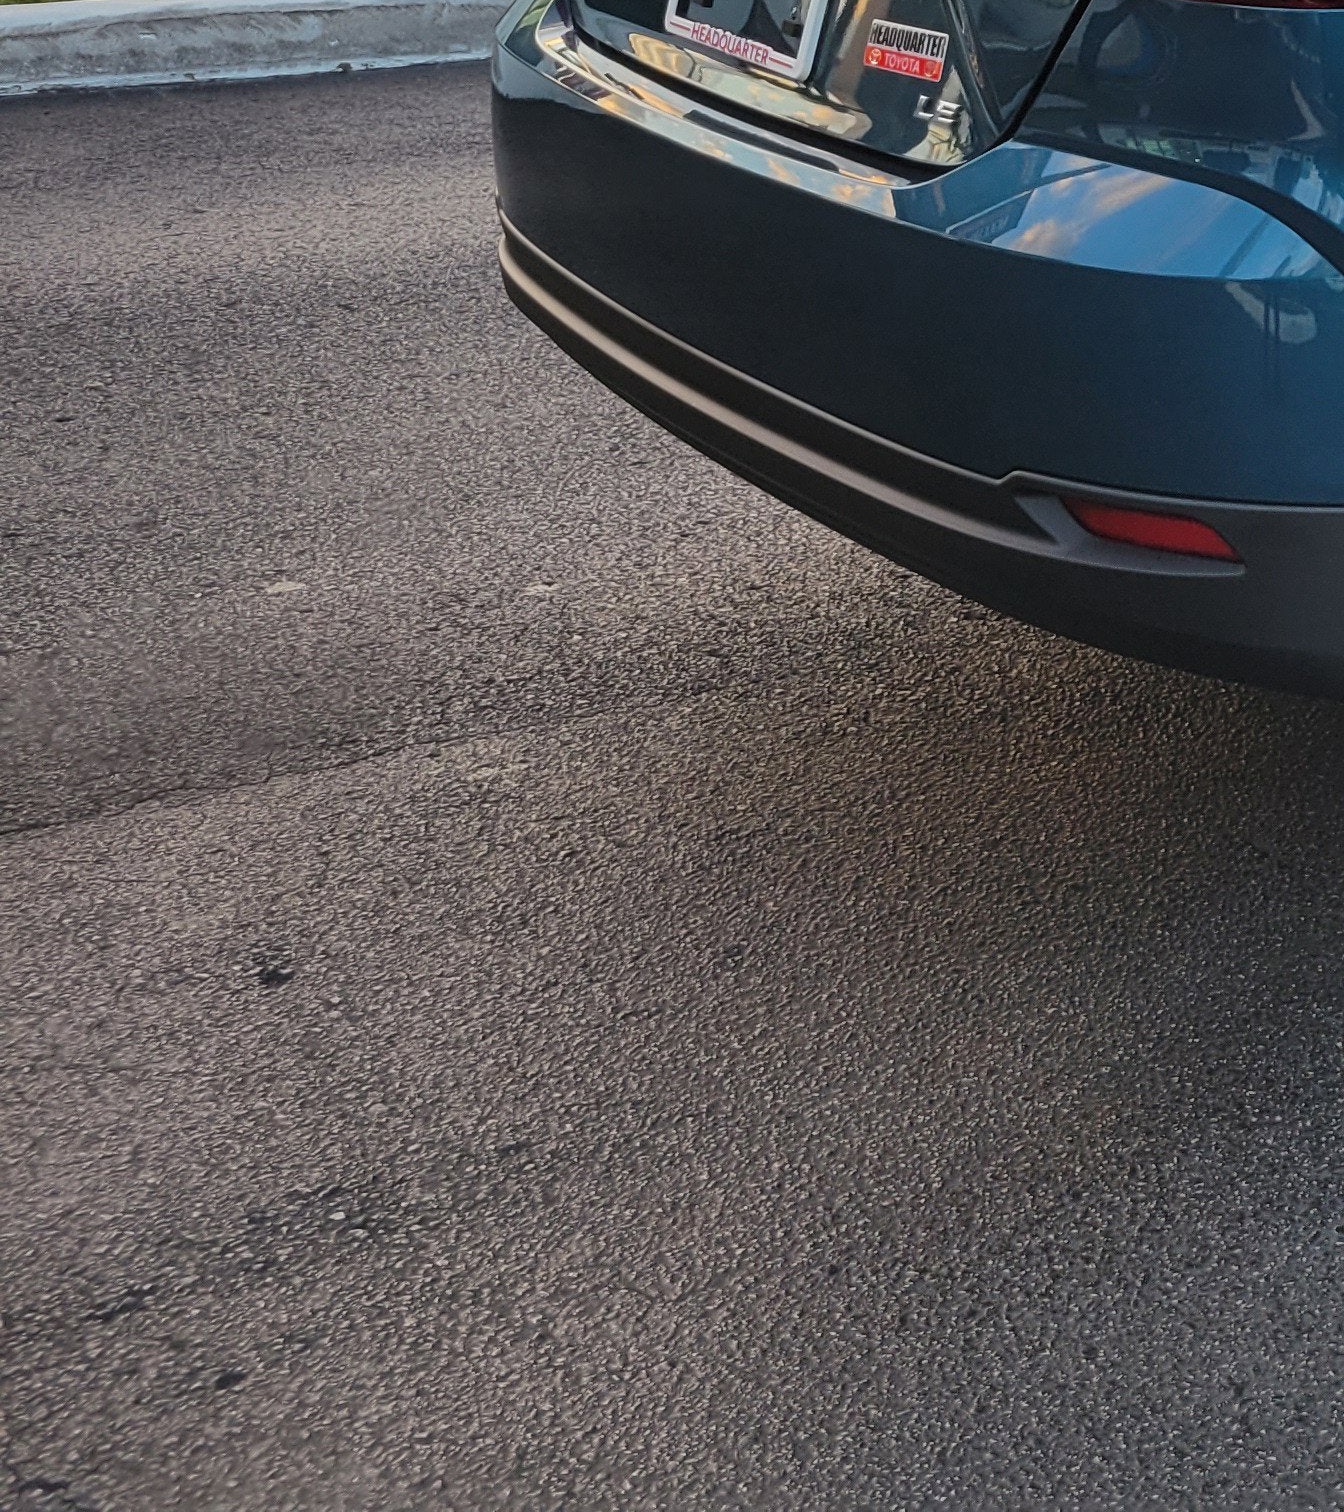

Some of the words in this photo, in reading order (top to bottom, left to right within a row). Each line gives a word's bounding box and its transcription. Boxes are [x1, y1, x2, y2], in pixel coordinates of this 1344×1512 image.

[690, 22, 770, 66] HEADQUARTER
[869, 23, 947, 59] HEADQUARTER
[884, 53, 920, 74] TOYOTA
[913, 95, 962, 124] LE
